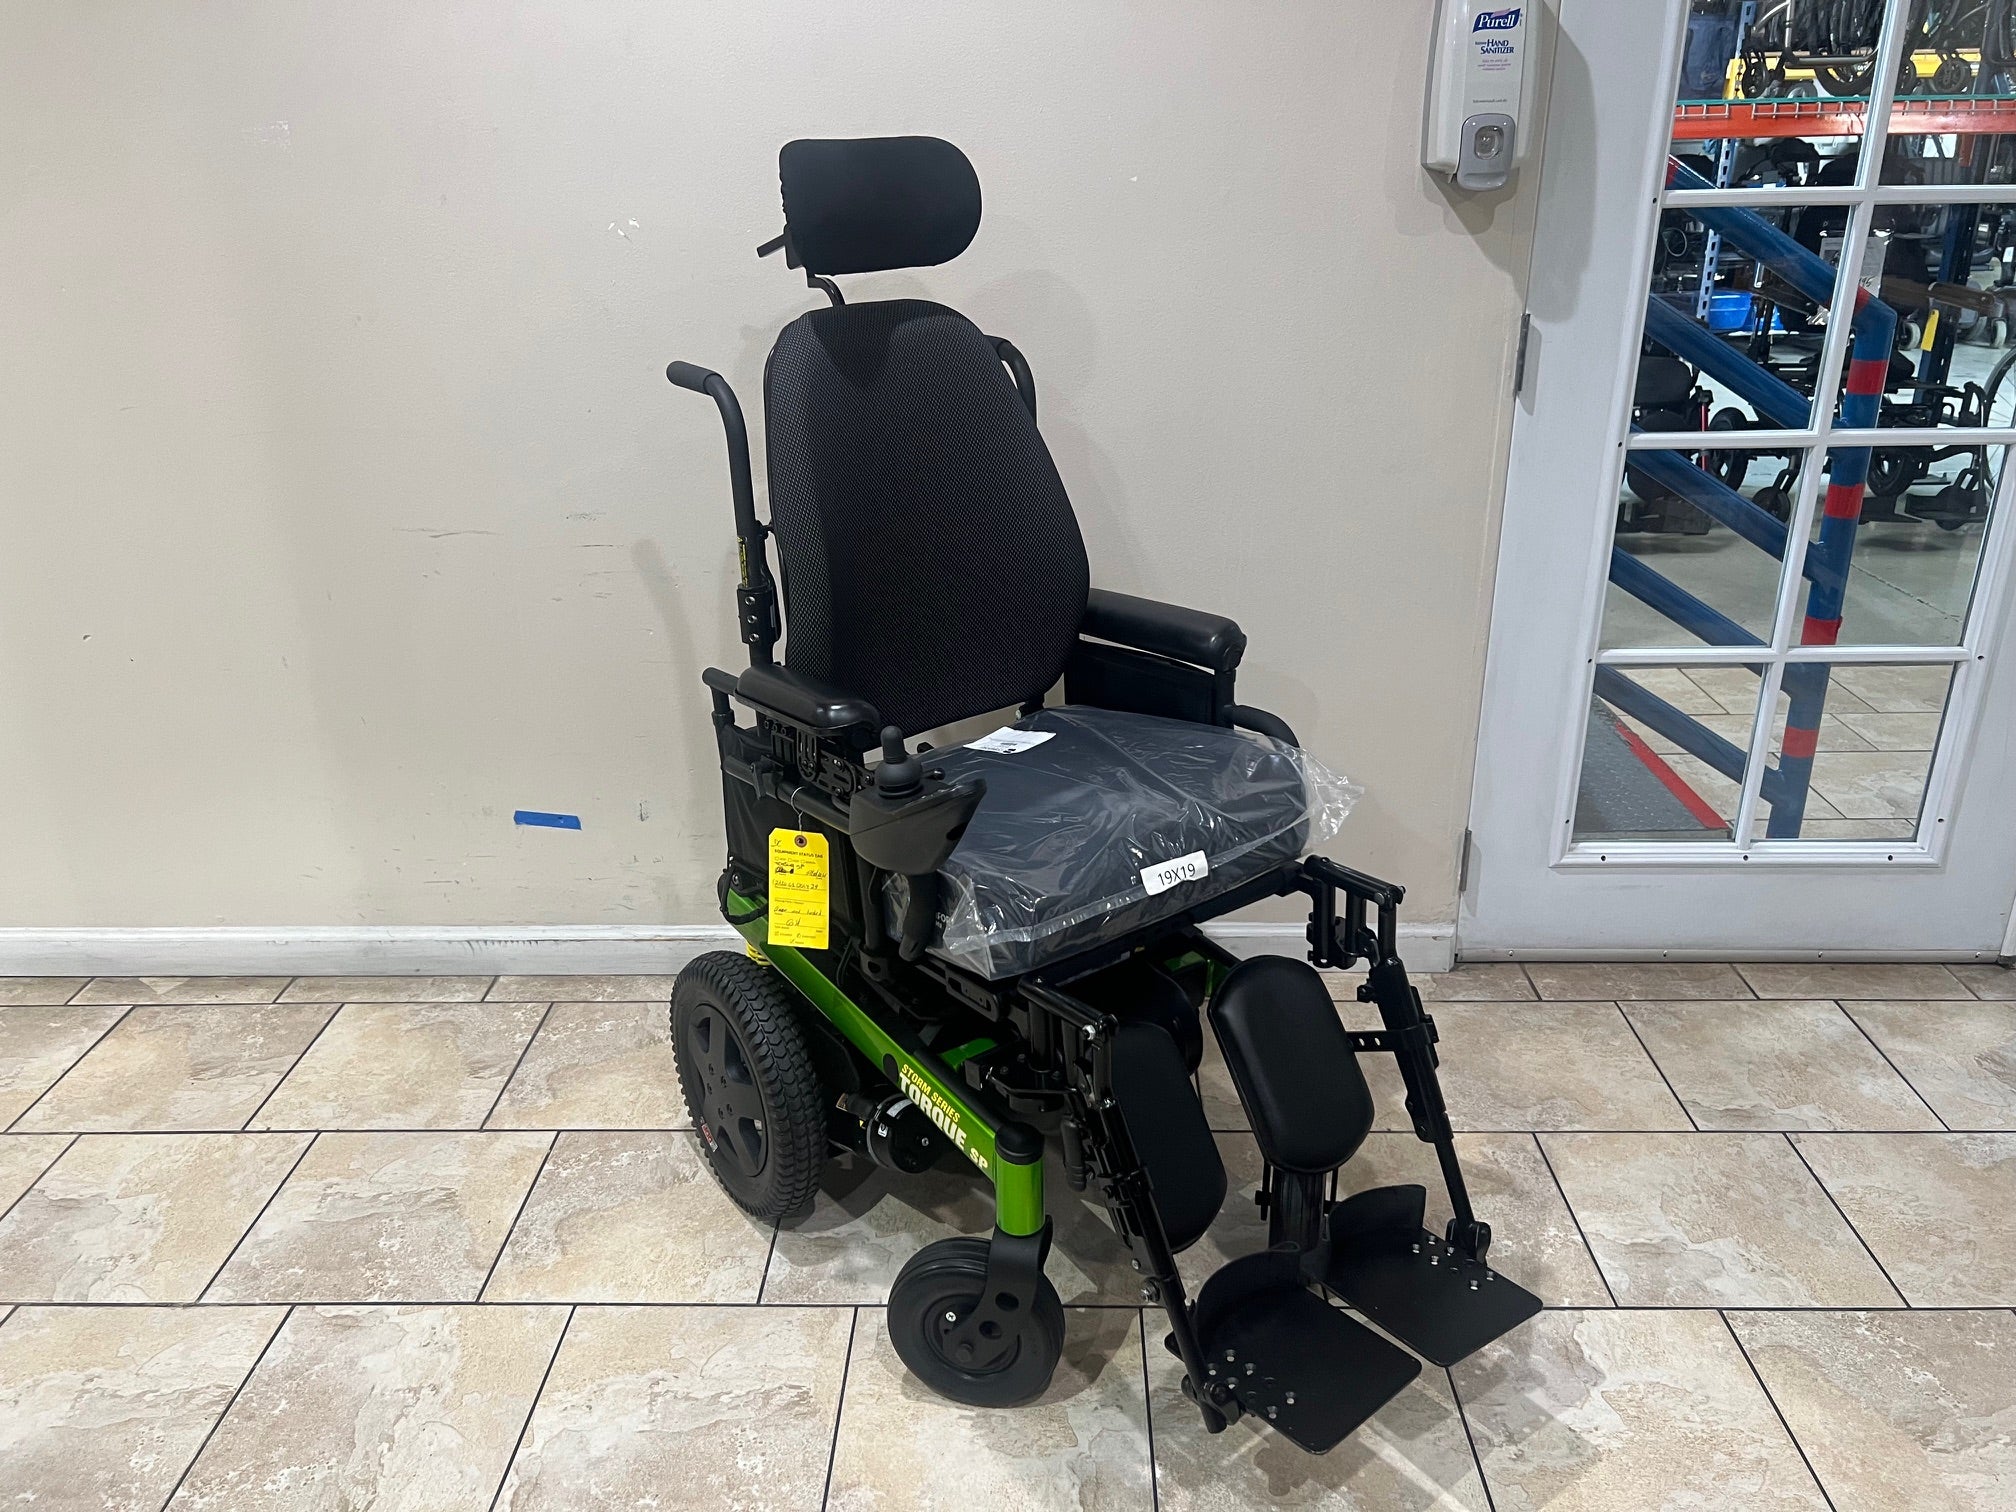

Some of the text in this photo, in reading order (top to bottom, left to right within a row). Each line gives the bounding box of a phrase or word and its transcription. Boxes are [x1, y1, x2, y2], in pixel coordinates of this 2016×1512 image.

[1478, 14, 1516, 28] Purell
[1480, 45, 1515, 54] SANITIZER
[1487, 38, 1509, 47] HAND
[1157, 863, 1196, 886] 19X19
[901, 1064, 960, 1122] STORM SERIES
[899, 1072, 988, 1169] TORQUE SP
